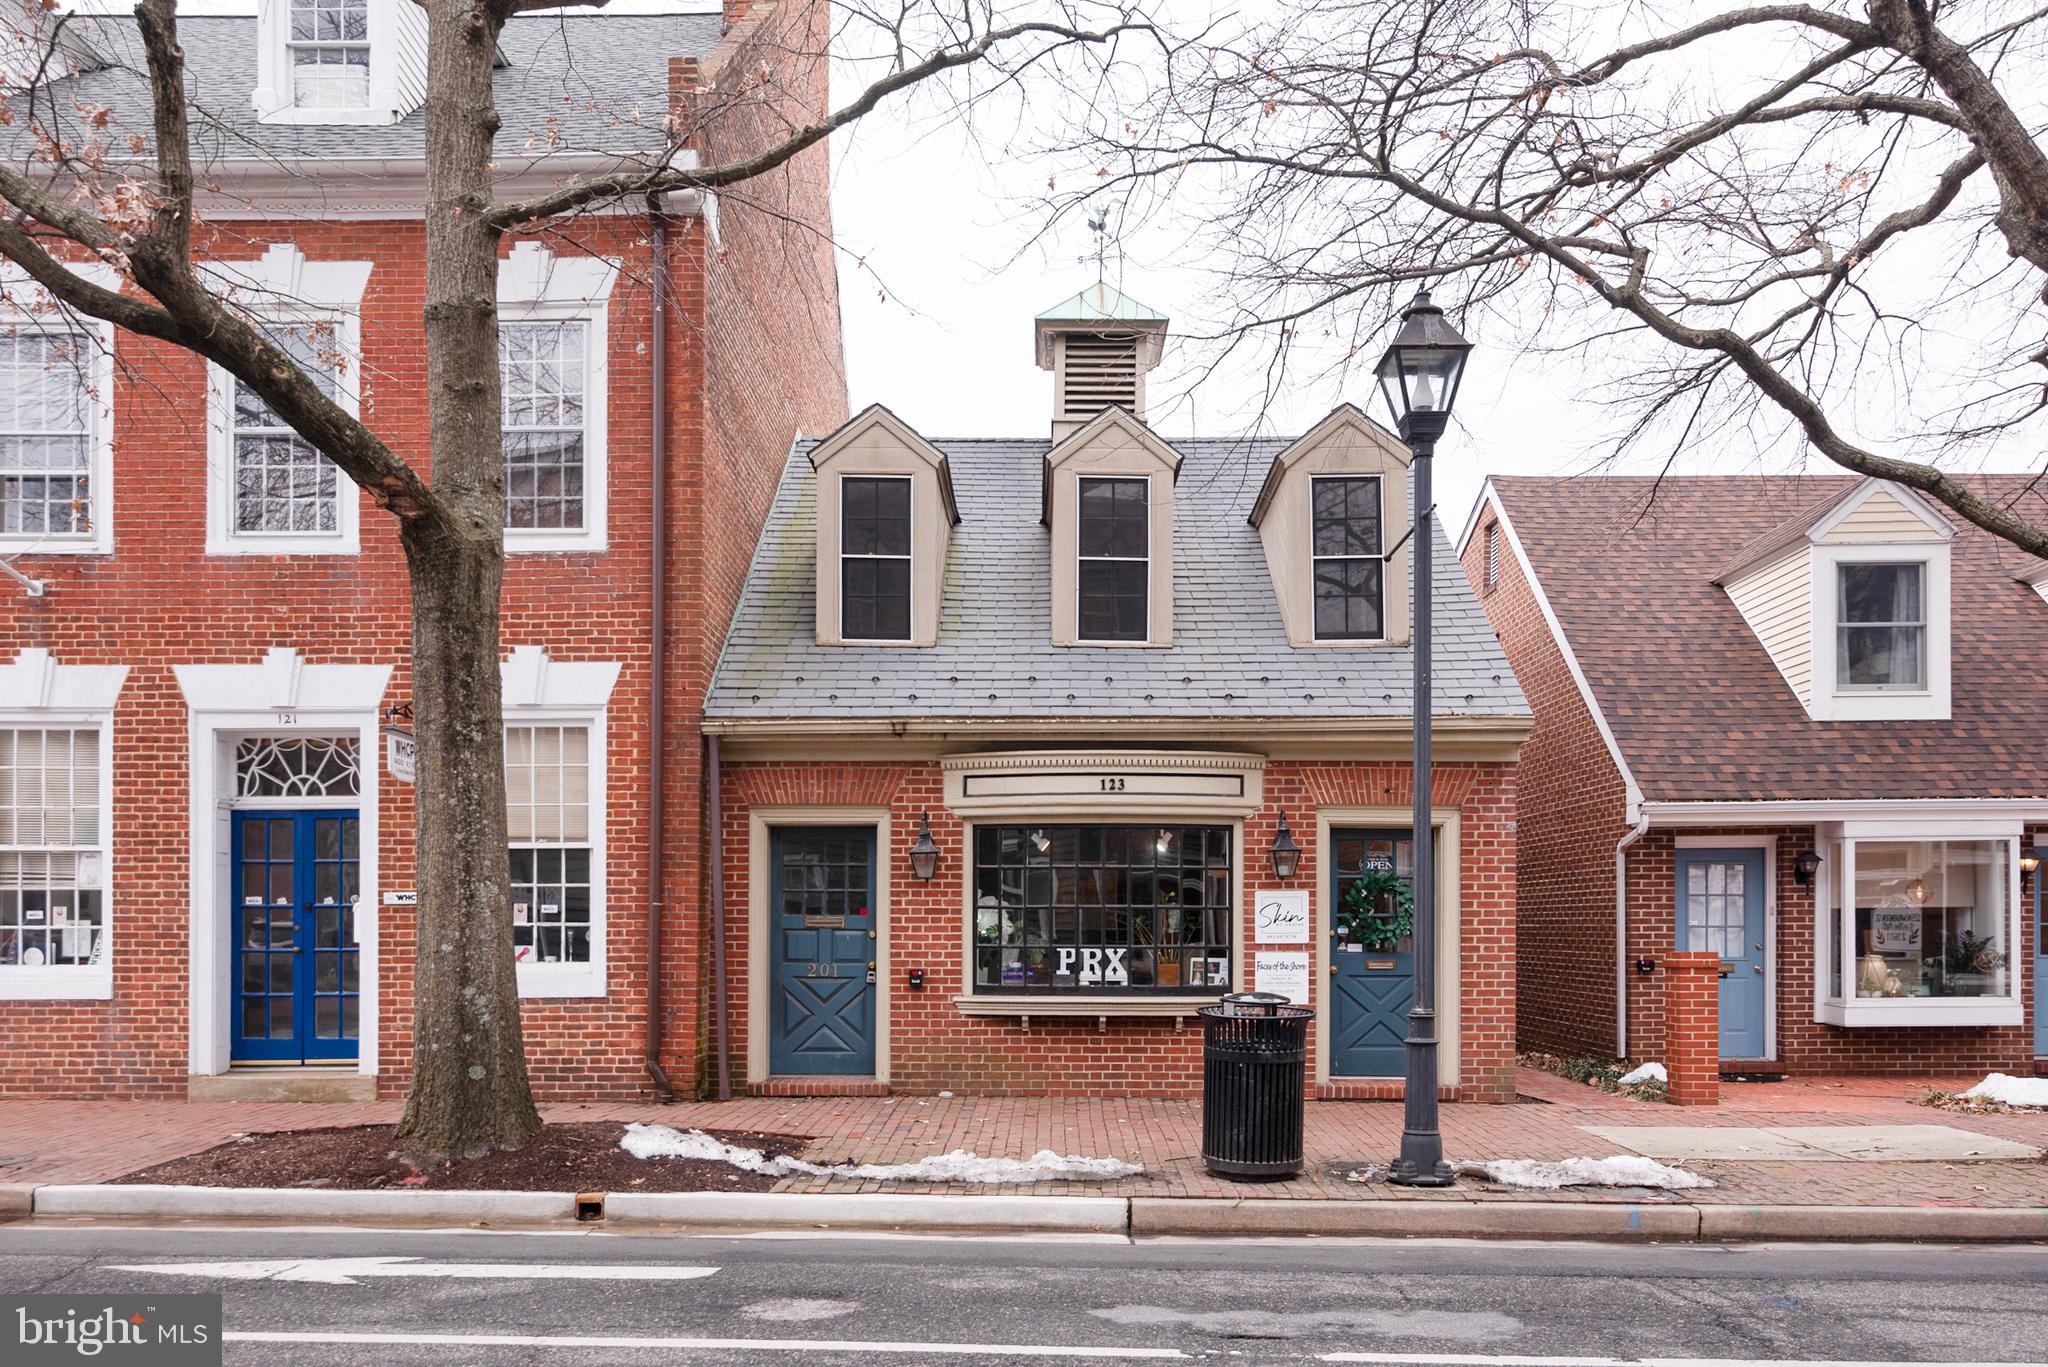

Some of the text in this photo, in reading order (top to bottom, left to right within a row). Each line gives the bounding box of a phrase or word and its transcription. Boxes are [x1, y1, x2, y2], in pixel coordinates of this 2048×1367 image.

[278, 713, 297, 724] 121
[1100, 777, 1126, 791] 123
[1259, 902, 1304, 928] Skin
[1056, 947, 1128, 977] PRX
[1257, 961, 1306, 972] Faces of the Shore
[807, 963, 838, 977] 201
